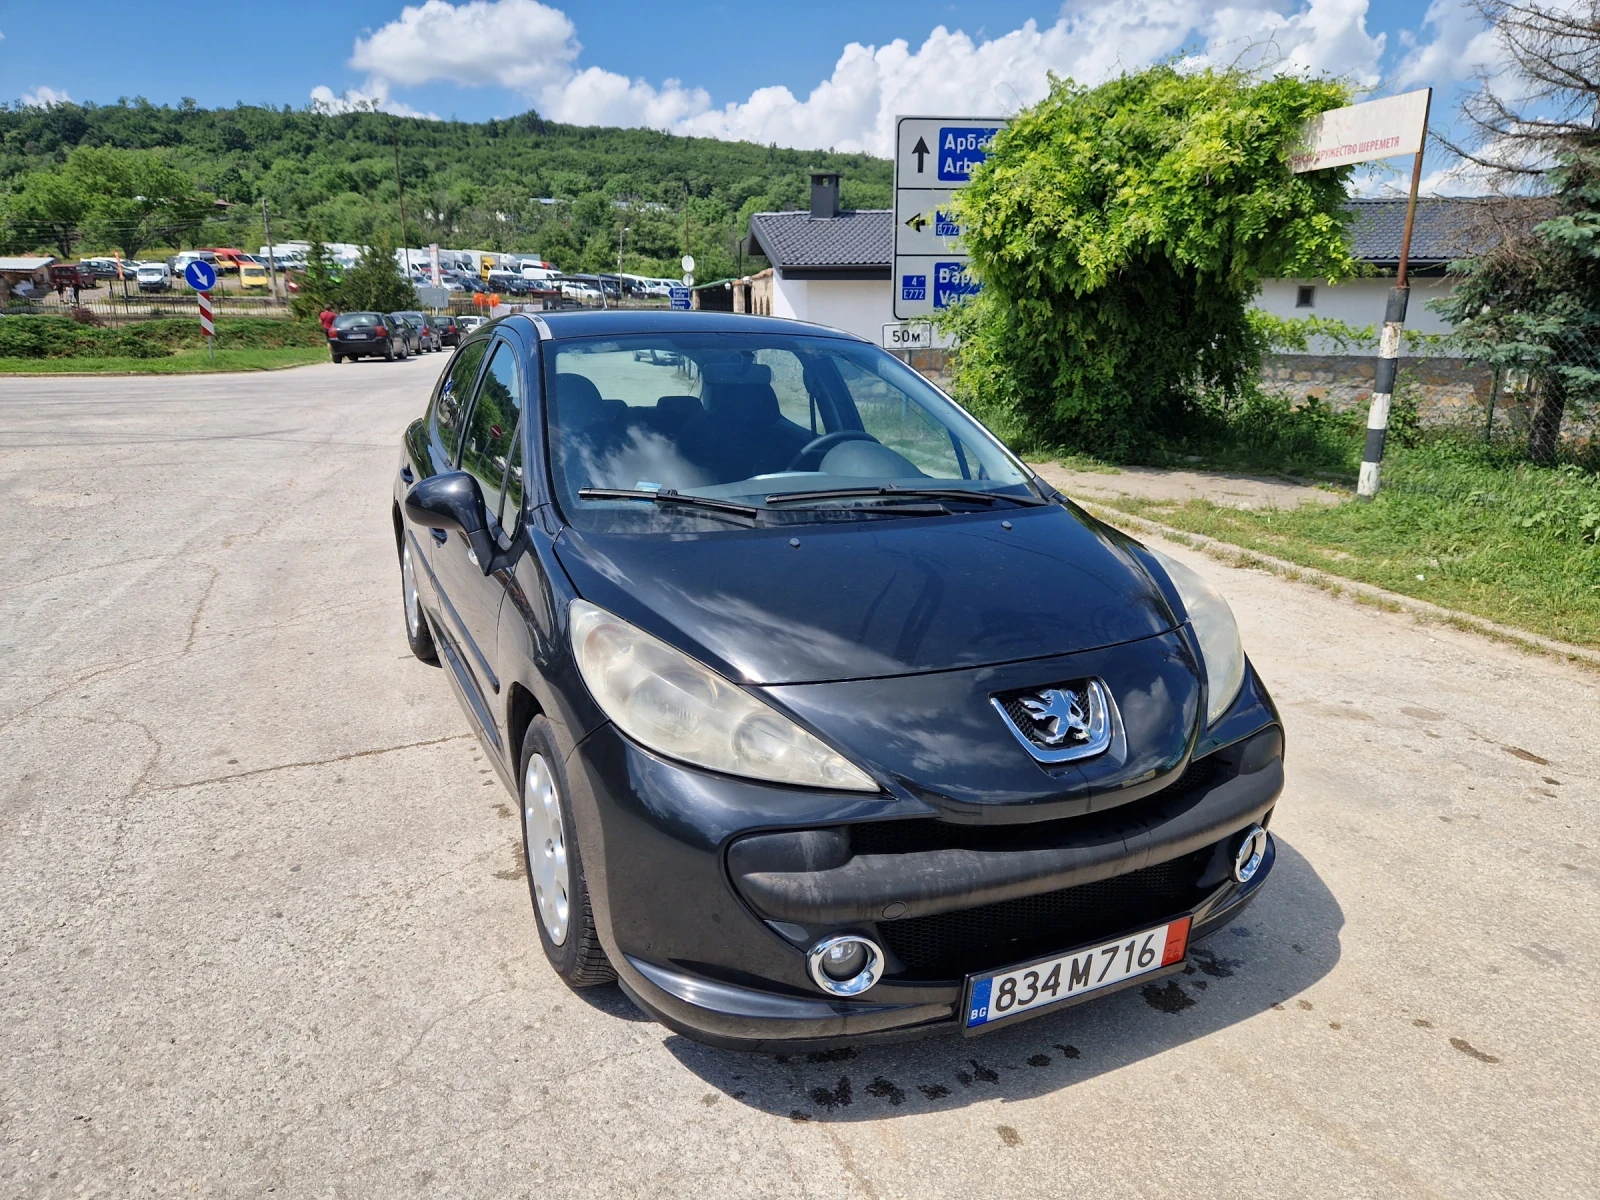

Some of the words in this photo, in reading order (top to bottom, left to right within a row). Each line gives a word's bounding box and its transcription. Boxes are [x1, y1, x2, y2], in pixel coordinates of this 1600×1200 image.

[944, 133, 991, 154] Арба
[1358, 136, 1400, 153] ШЕРЕМЕТЯ
[943, 157, 981, 173] Arb
[911, 276, 917, 286] 4
[903, 289, 925, 299] E772
[970, 1006, 987, 1020] BG
